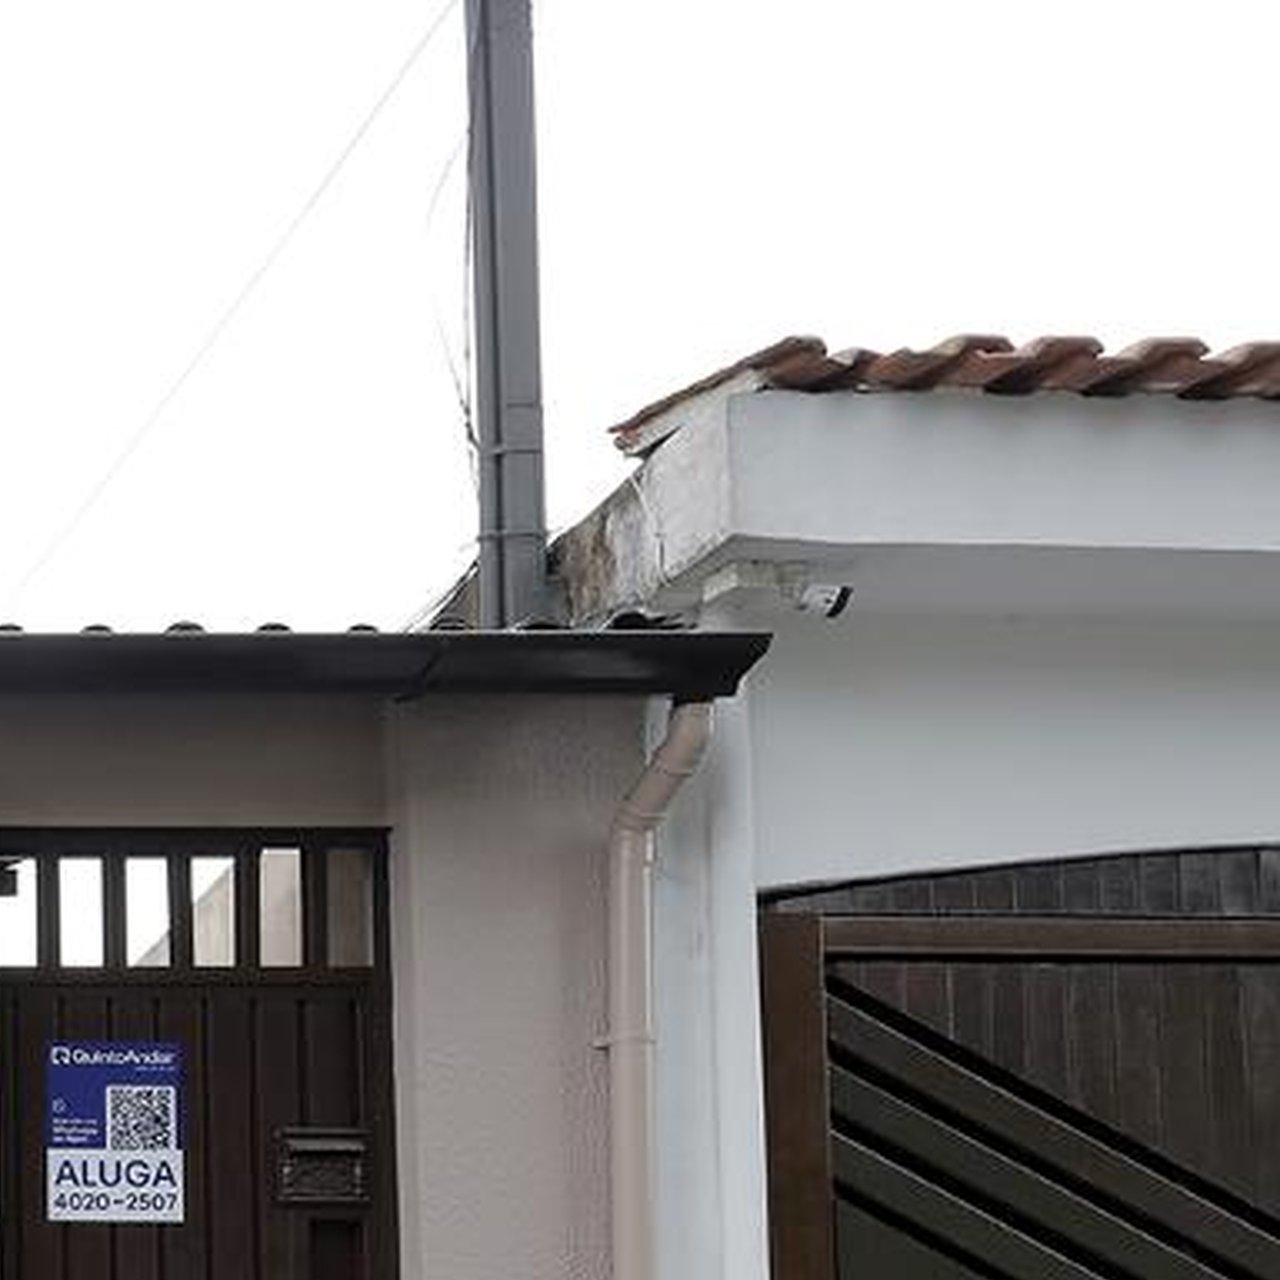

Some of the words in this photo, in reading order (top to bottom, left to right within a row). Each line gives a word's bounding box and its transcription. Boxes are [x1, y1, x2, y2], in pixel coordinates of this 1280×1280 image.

[72, 1050, 175, 1064] QuintoAndar
[55, 1160, 176, 1187] ALUGA
[54, 1193, 177, 1211] 4020-2507
